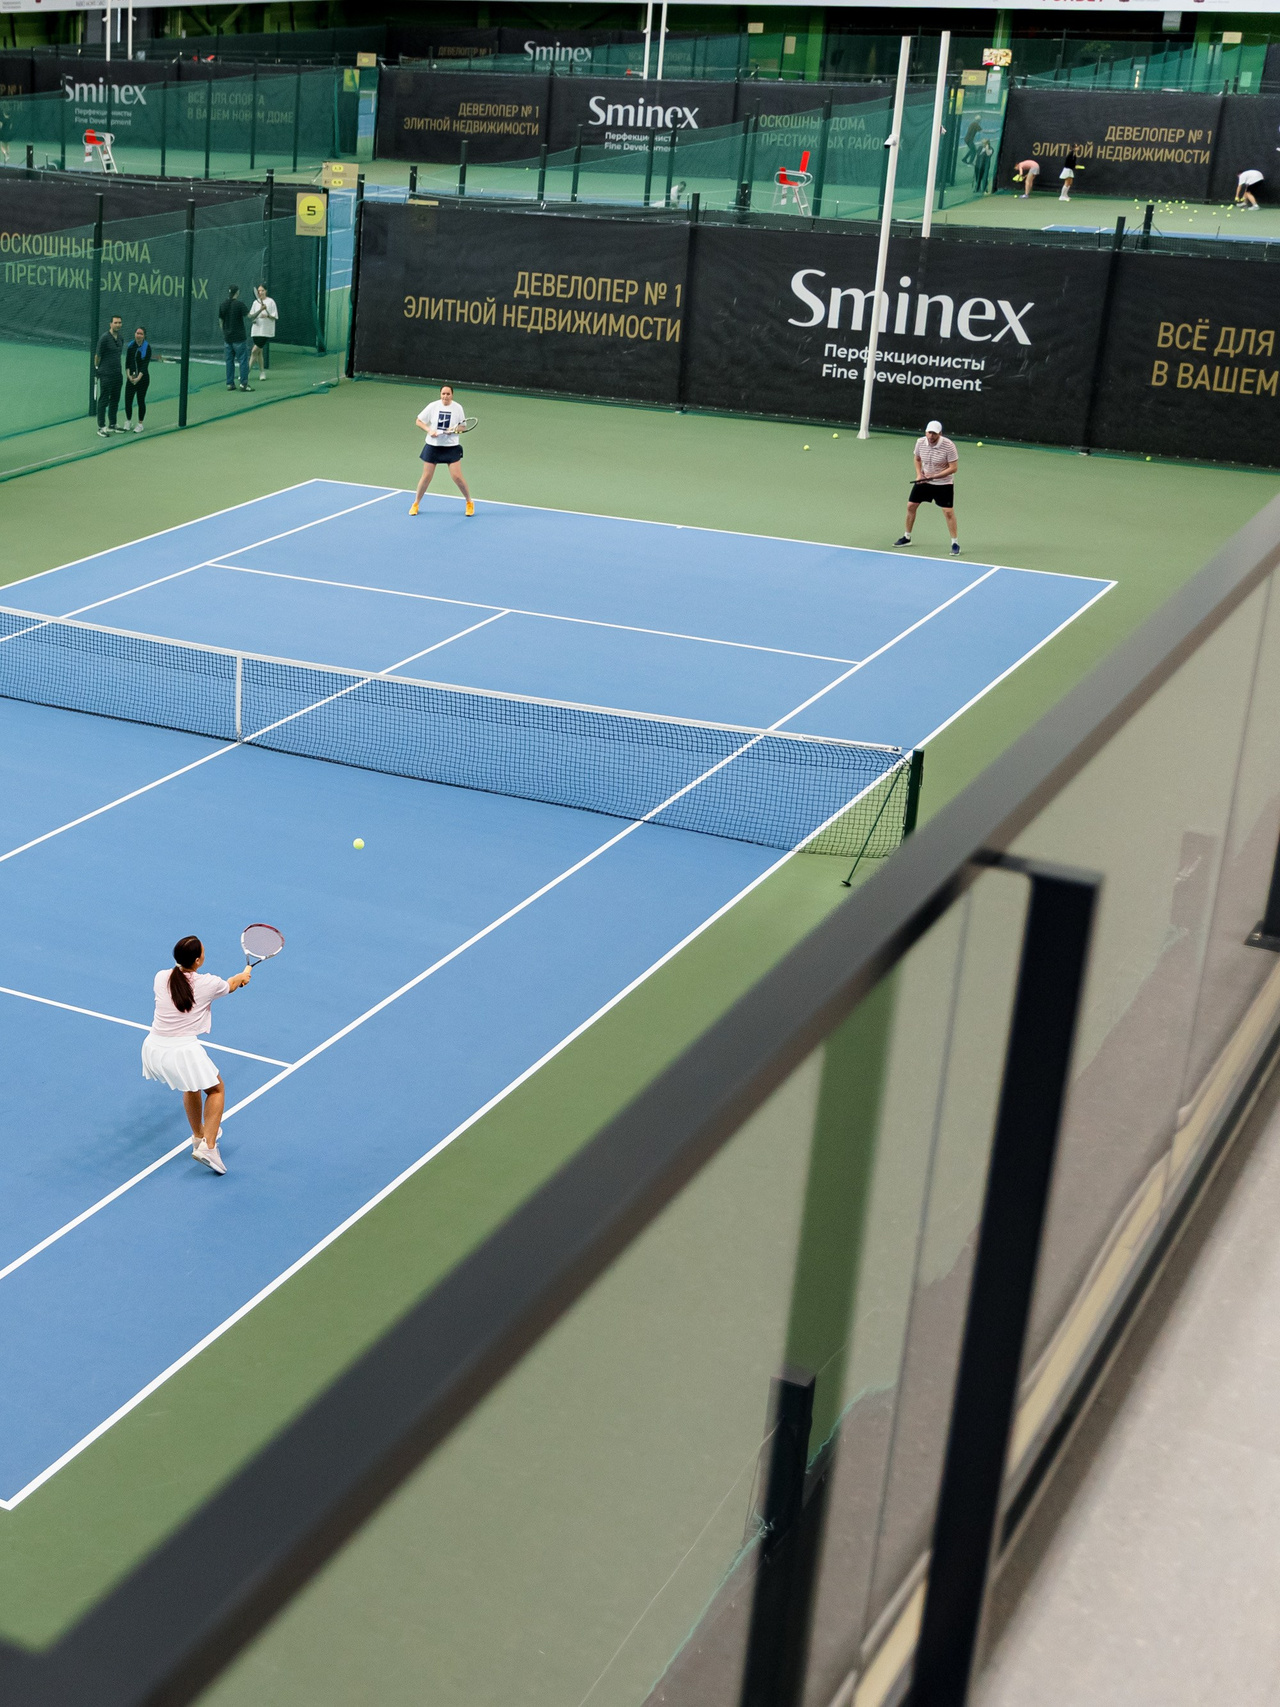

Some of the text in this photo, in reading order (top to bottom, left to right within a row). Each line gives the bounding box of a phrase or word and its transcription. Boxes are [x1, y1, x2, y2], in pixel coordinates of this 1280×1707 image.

[60, 75, 147, 105] Sminex
[458, 102, 539, 118] ДЕВЕЛОПЕР № 1
[588, 95, 699, 129] Sminex
[404, 116, 539, 136] ЭЛИТНОЙ НЕДВИЖИМОСТИ
[759, 114, 866, 131] ОСКОШНЫ ДОМА
[761, 133, 844, 148] ПРЕСТИЖЫХ
[1105, 125, 1212, 144] ДЕВЕЛОПЕР № 1
[1096, 145, 1210, 164] НЕДВИЖИМОСТИ
[306, 205, 317, 216] 5
[100, 239, 151, 264] ДОМА
[513, 271, 682, 308] ДЕВЕЛОПЕР № 1
[788, 268, 1035, 346] Sminex
[403, 295, 681, 343] ЭЛИТНОЙ НЕДВИЖИМОСТИ
[1157, 318, 1275, 358] ВСЁ ДЛЯ
[821, 363, 859, 380] Fine
[1151, 360, 1279, 397] В ВАШЕМ
